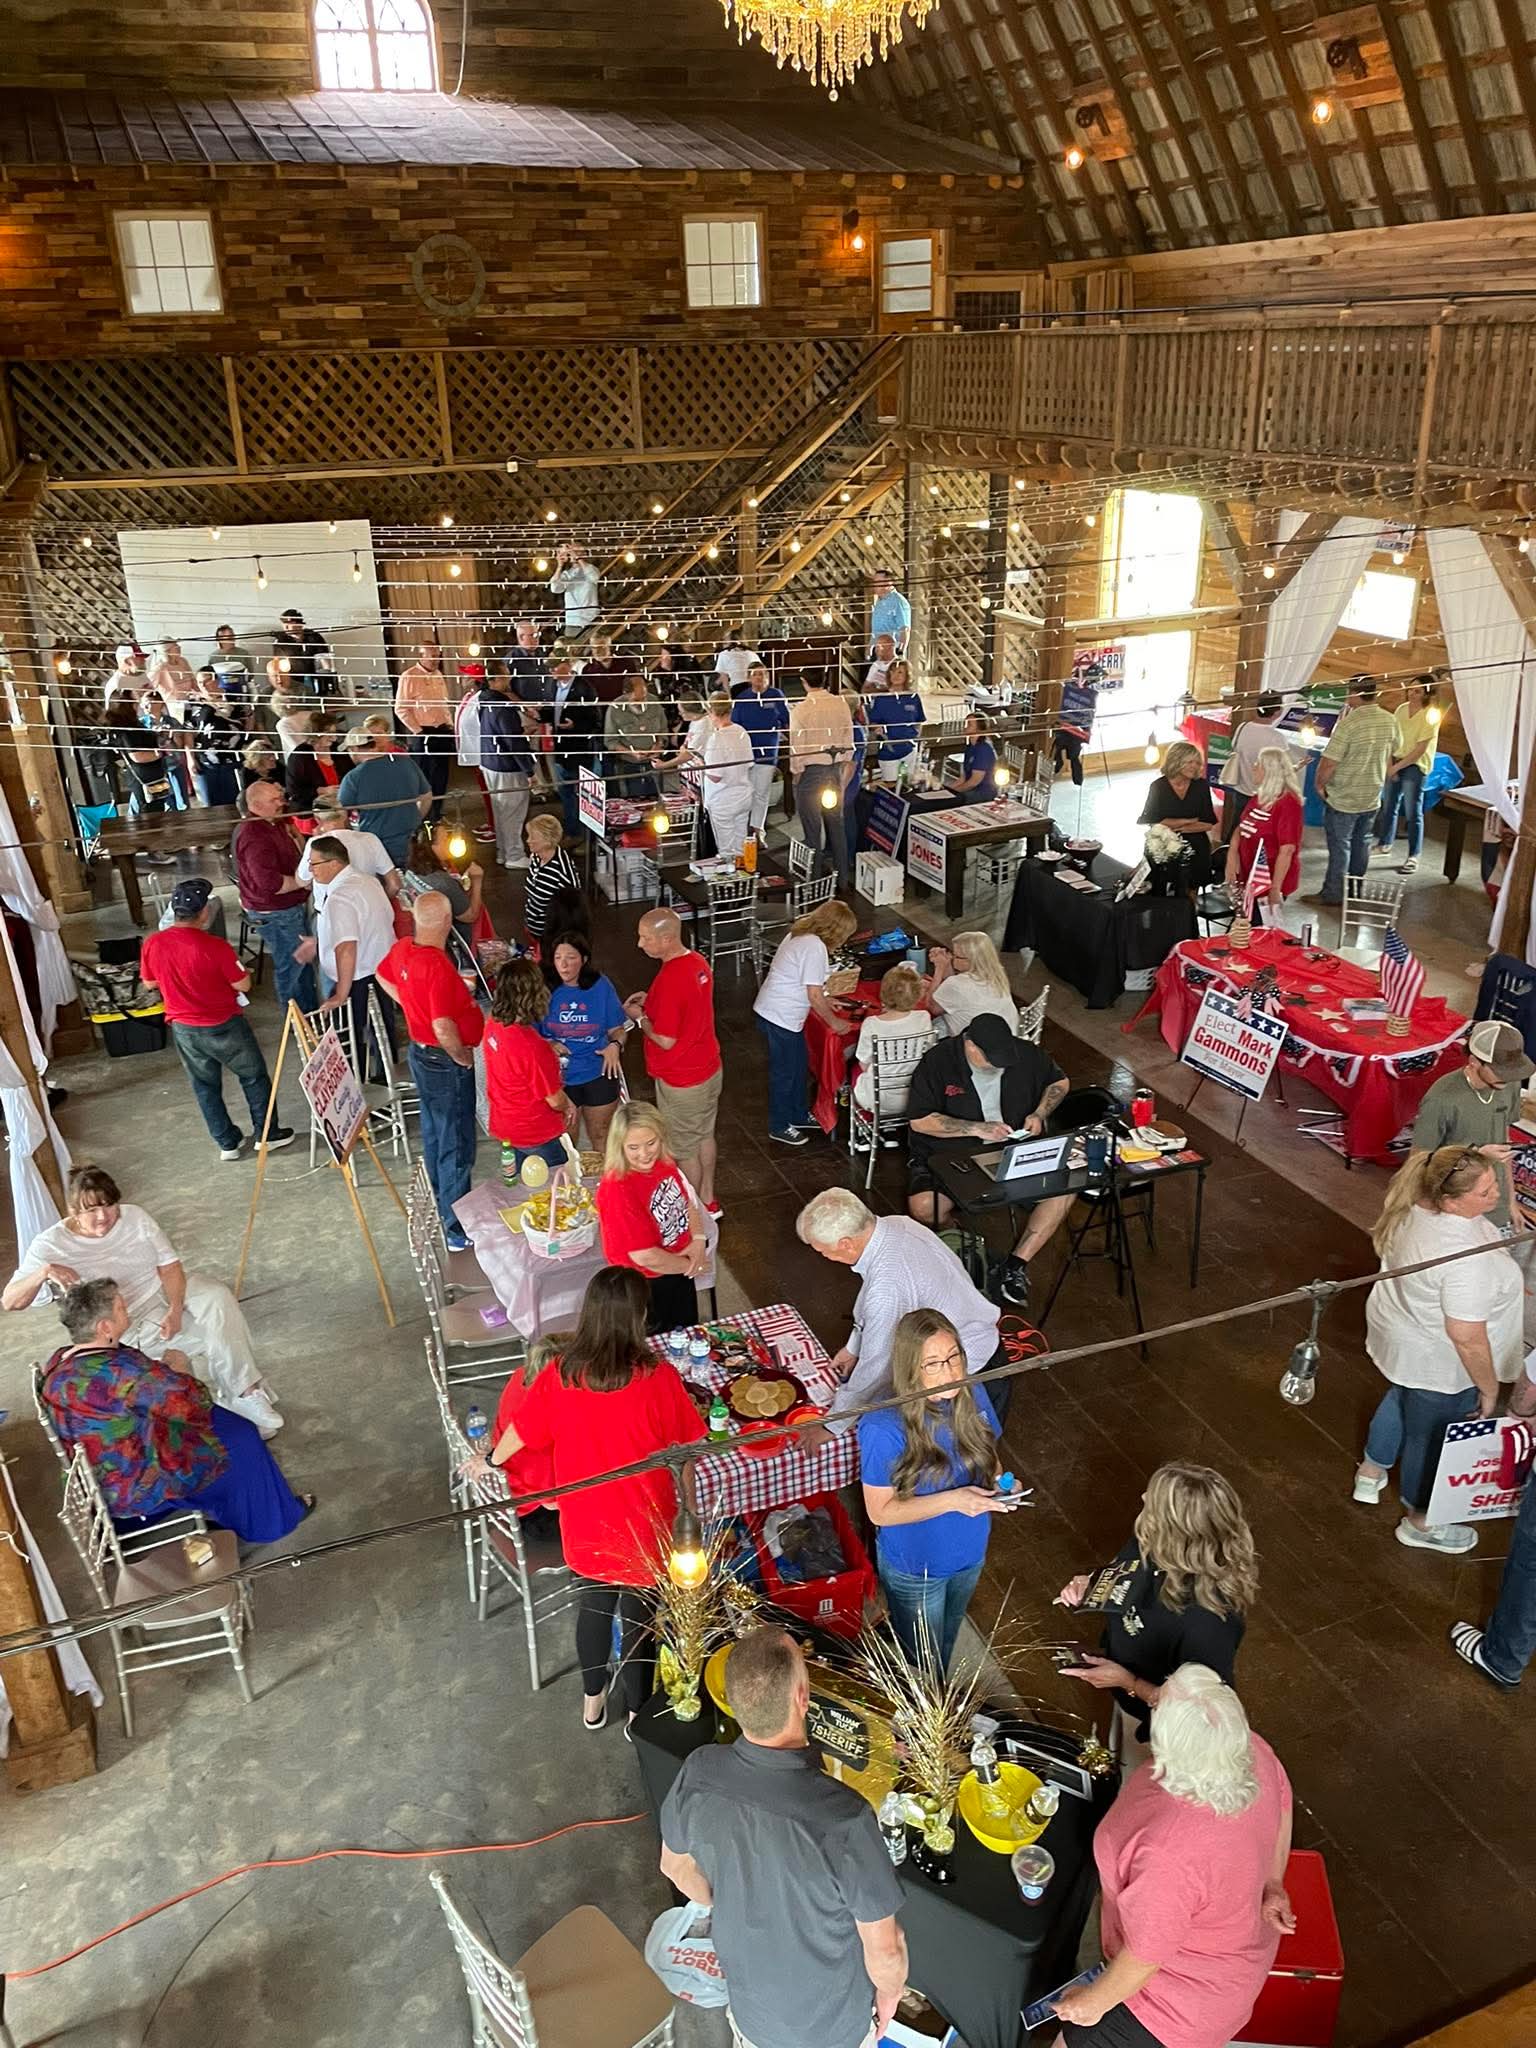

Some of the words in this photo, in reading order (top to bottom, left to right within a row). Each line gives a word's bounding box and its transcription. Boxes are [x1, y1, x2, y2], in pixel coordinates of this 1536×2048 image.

[910, 842, 943, 870] JONES
[560, 1011, 589, 1023] VOTE
[1204, 1014, 1237, 1035] Elect
[1237, 1030, 1274, 1059] Mark
[1194, 1026, 1268, 1075] Gammons
[1518, 1154, 1536, 1174] JO
[1472, 1457, 1502, 1468] JOS
[835, 1719, 854, 1734] TUCK
[815, 1725, 864, 1755] SHERIFF
[667, 1946, 721, 1968] HOBB
